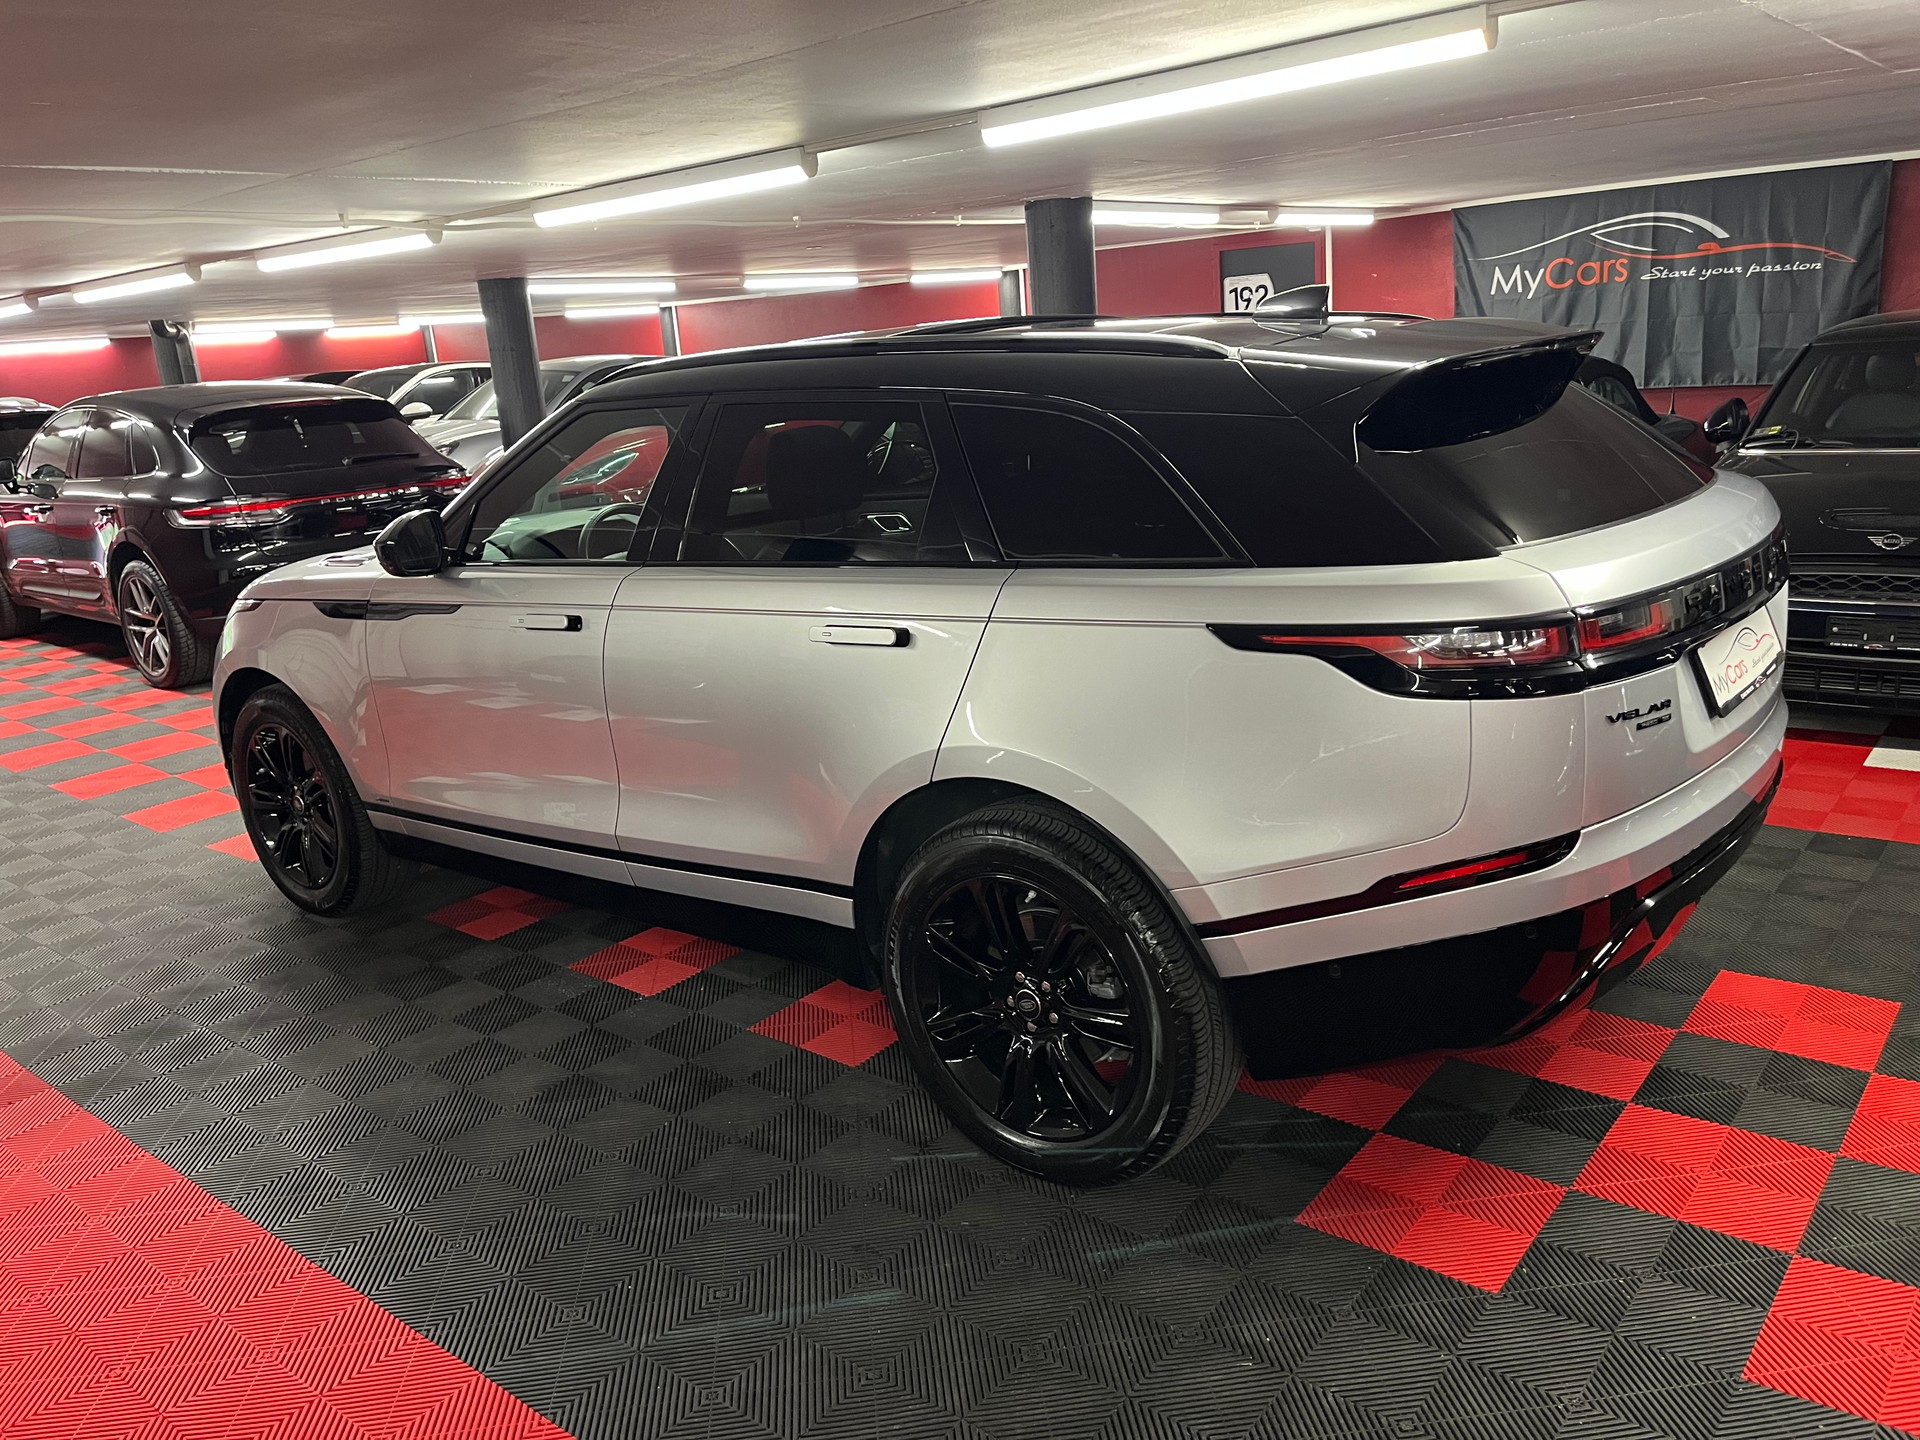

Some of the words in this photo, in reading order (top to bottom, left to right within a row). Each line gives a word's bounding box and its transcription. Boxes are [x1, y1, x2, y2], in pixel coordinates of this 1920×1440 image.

[1490, 257, 1629, 300] MyCars
[1640, 266, 1697, 281] Start
[1699, 266, 1743, 281] your
[1745, 261, 1823, 278] passion
[1229, 284, 1269, 311] 192
[1712, 659, 1748, 696] MyCars
[1606, 699, 1671, 723] VELAR
